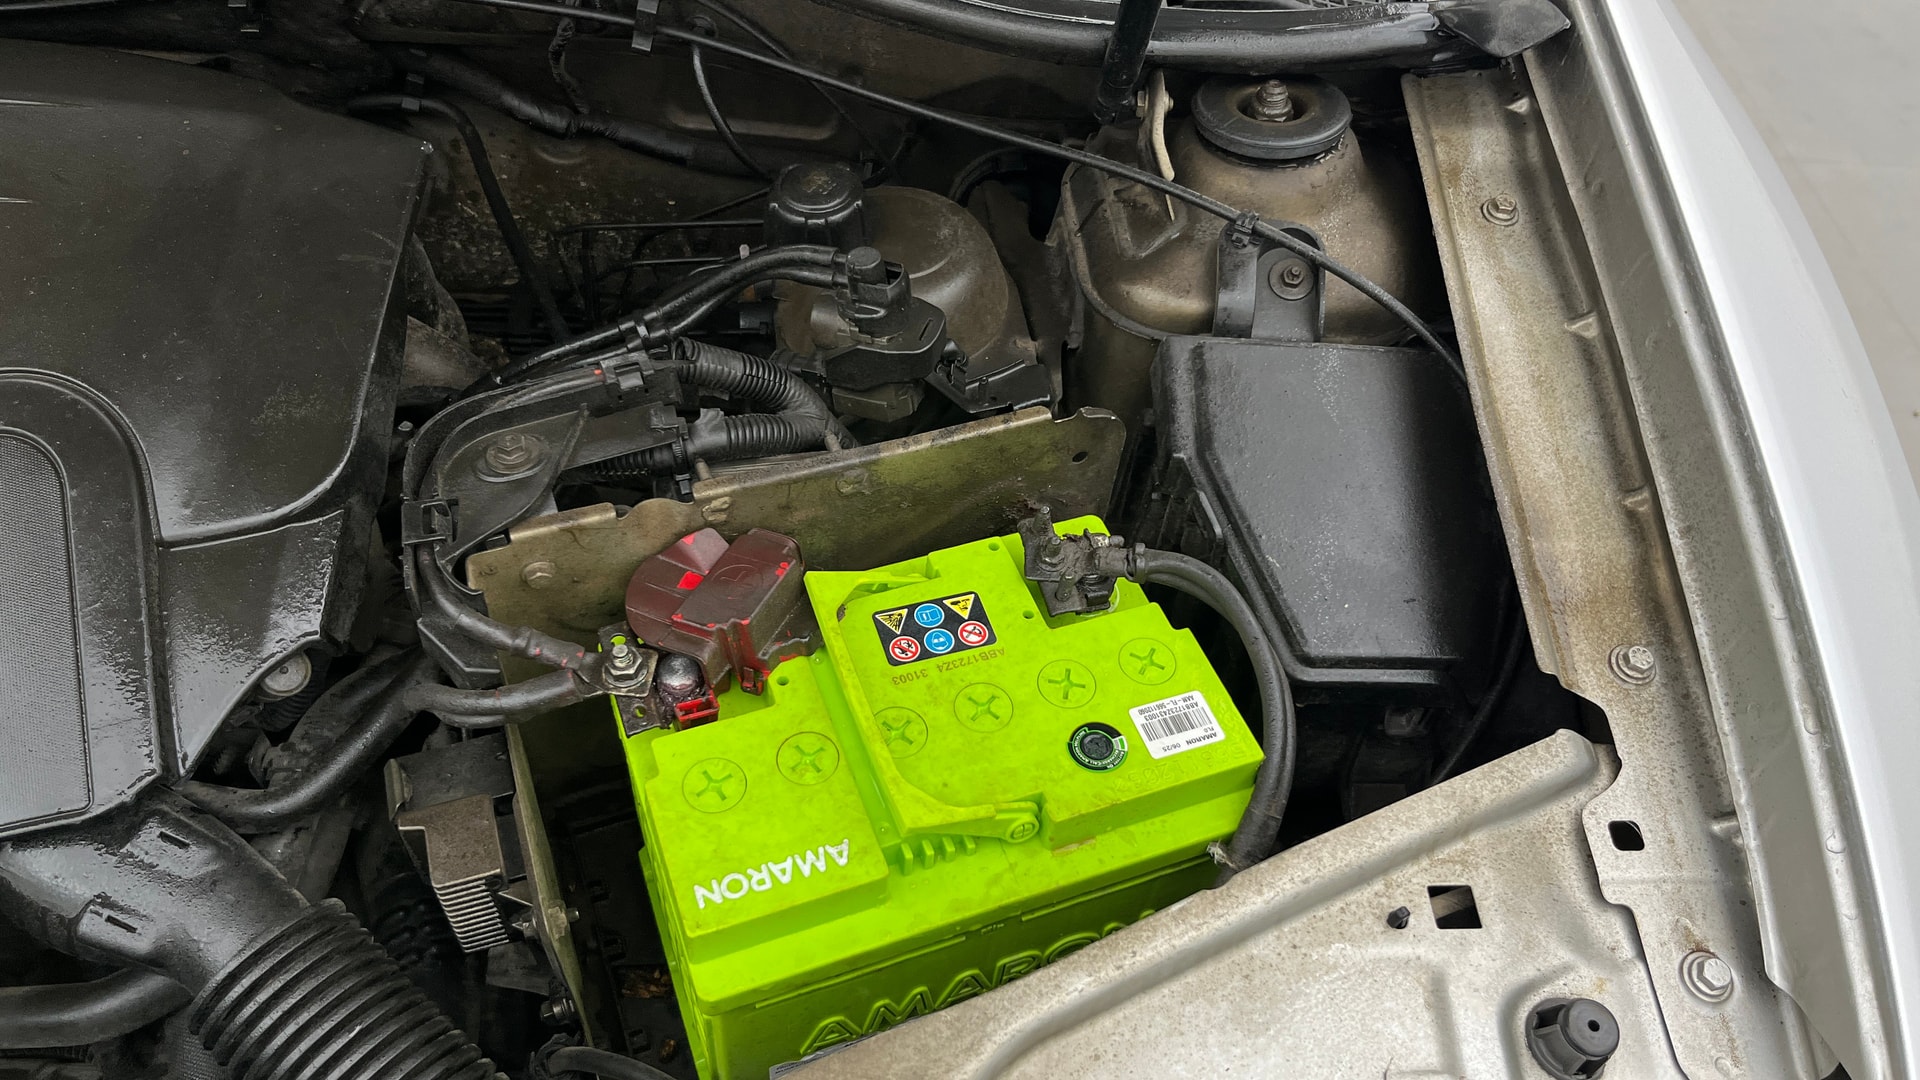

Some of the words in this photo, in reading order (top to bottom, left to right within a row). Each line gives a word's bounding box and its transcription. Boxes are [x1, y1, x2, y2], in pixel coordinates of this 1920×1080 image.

[936, 647, 1005, 673] ABB1723Z4
[891, 668, 928, 686] 31003
[1162, 742, 1181, 753] 06/25
[1185, 732, 1217, 746] AMARON
[693, 838, 849, 909] AMARON
[800, 909, 1156, 1055] AMARO
